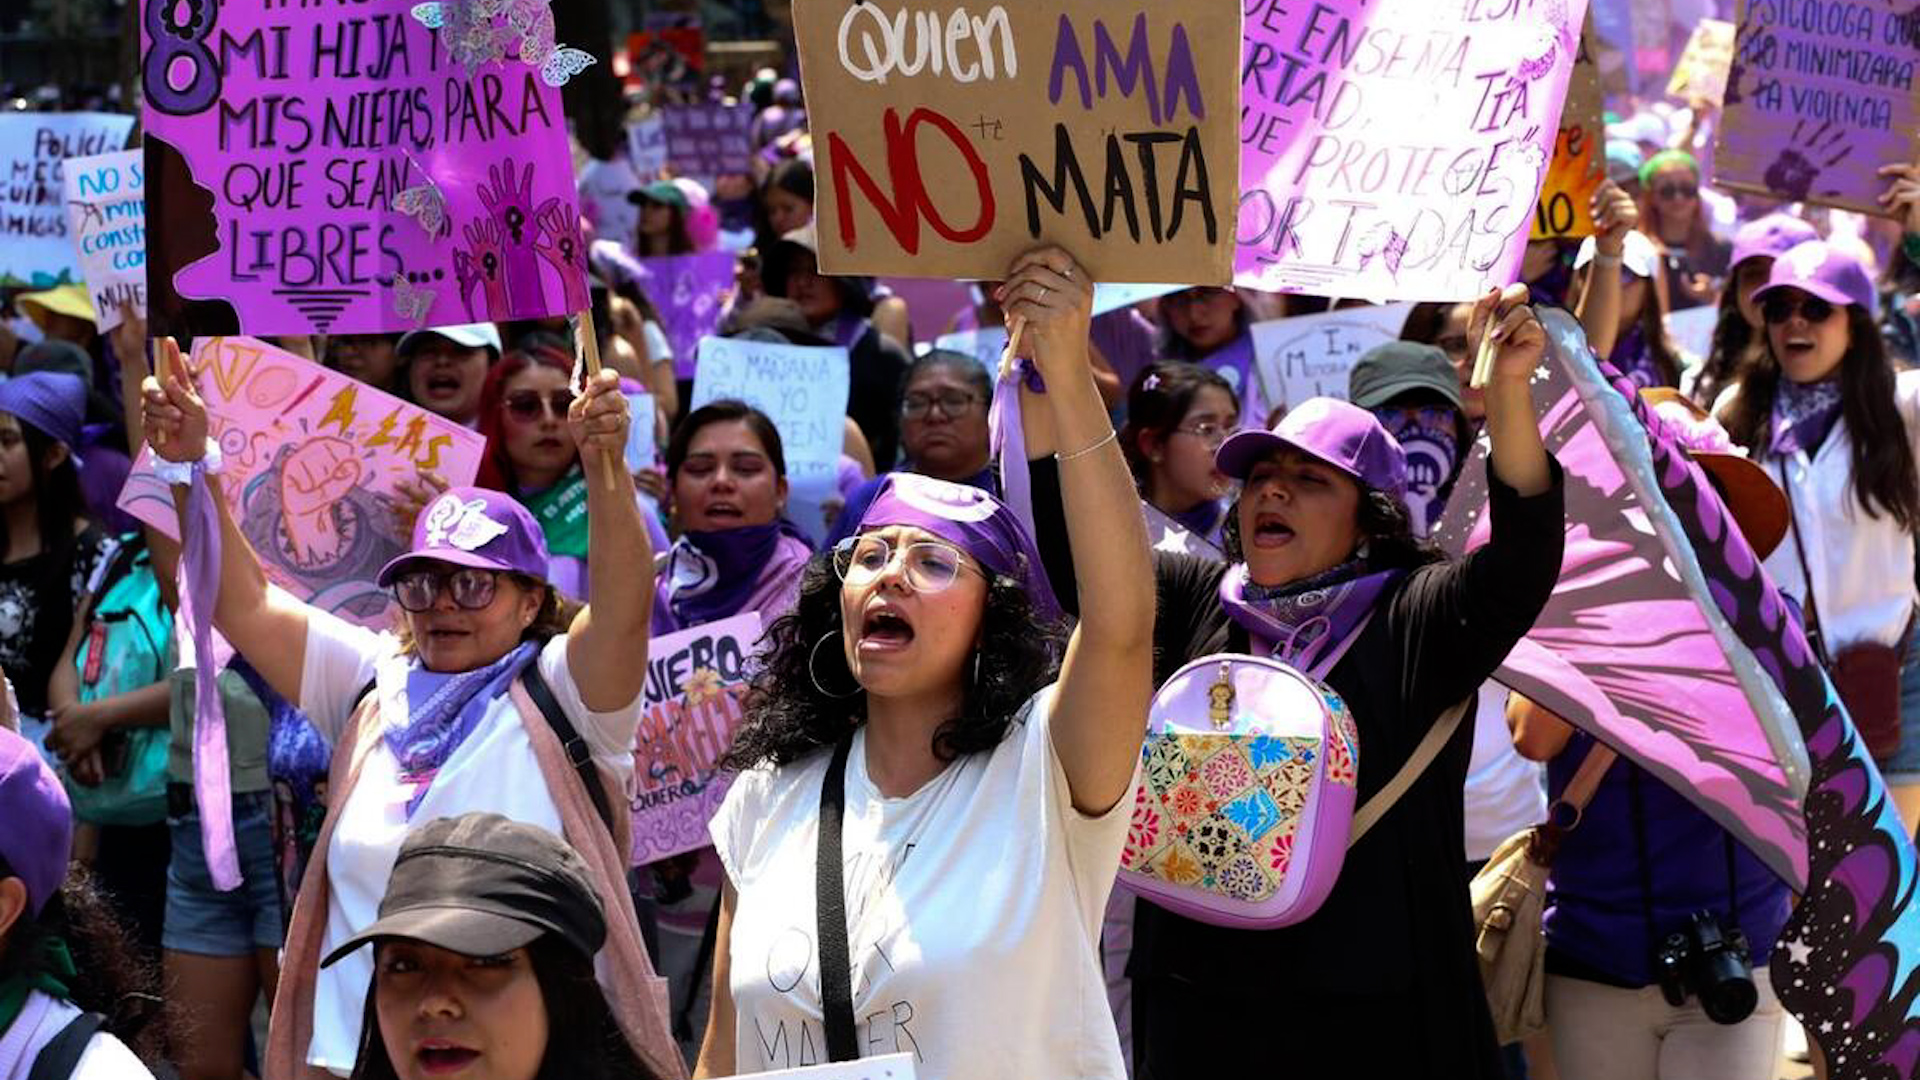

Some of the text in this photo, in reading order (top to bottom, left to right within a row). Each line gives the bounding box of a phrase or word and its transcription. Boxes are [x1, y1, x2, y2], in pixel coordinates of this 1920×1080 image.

[219, 26, 291, 80] MI
[311, 14, 410, 80] HIJA
[1048, 13, 1206, 126] AMA
[219, 71, 551, 153] MIS NIETAS, PARA
[1242, 36, 1372, 131] RTAD,
[1791, 85, 1893, 130] VIOLENCIA
[79, 168, 120, 197] NO
[224, 156, 410, 213] QUE SEAN
[827, 107, 997, 255] NO
[1018, 123, 1217, 245] MATA
[1236, 188, 1315, 260] OR
